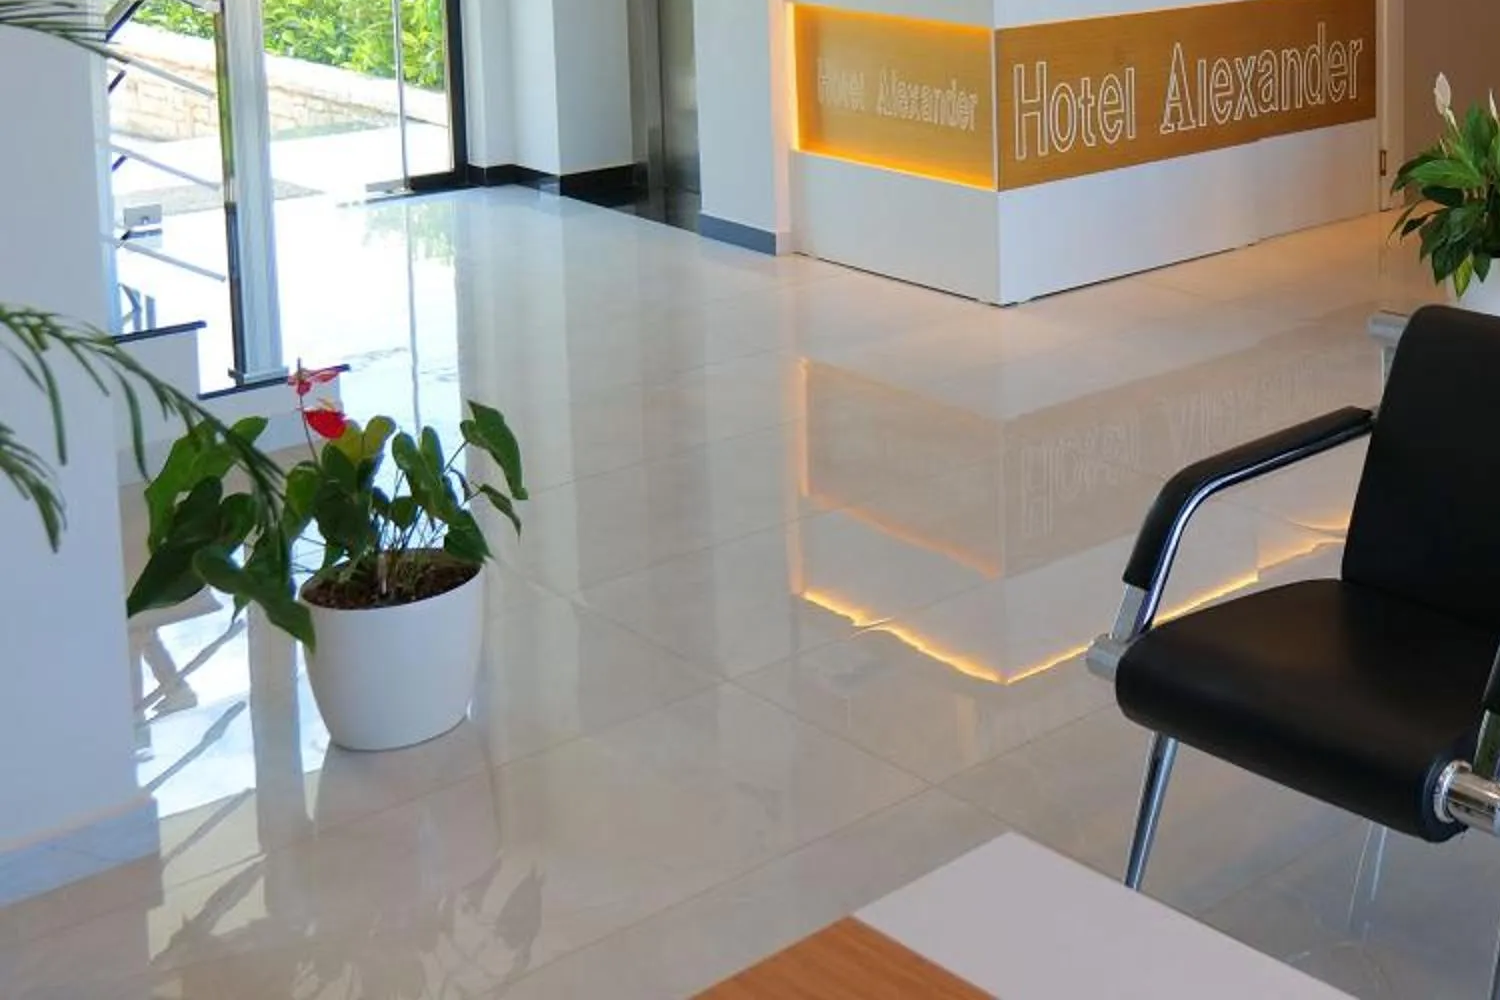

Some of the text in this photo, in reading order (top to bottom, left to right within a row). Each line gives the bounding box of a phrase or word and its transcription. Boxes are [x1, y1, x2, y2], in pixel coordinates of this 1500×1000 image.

[876, 66, 978, 132] Alexander
[1013, 21, 1363, 161] Hotel Alexander
